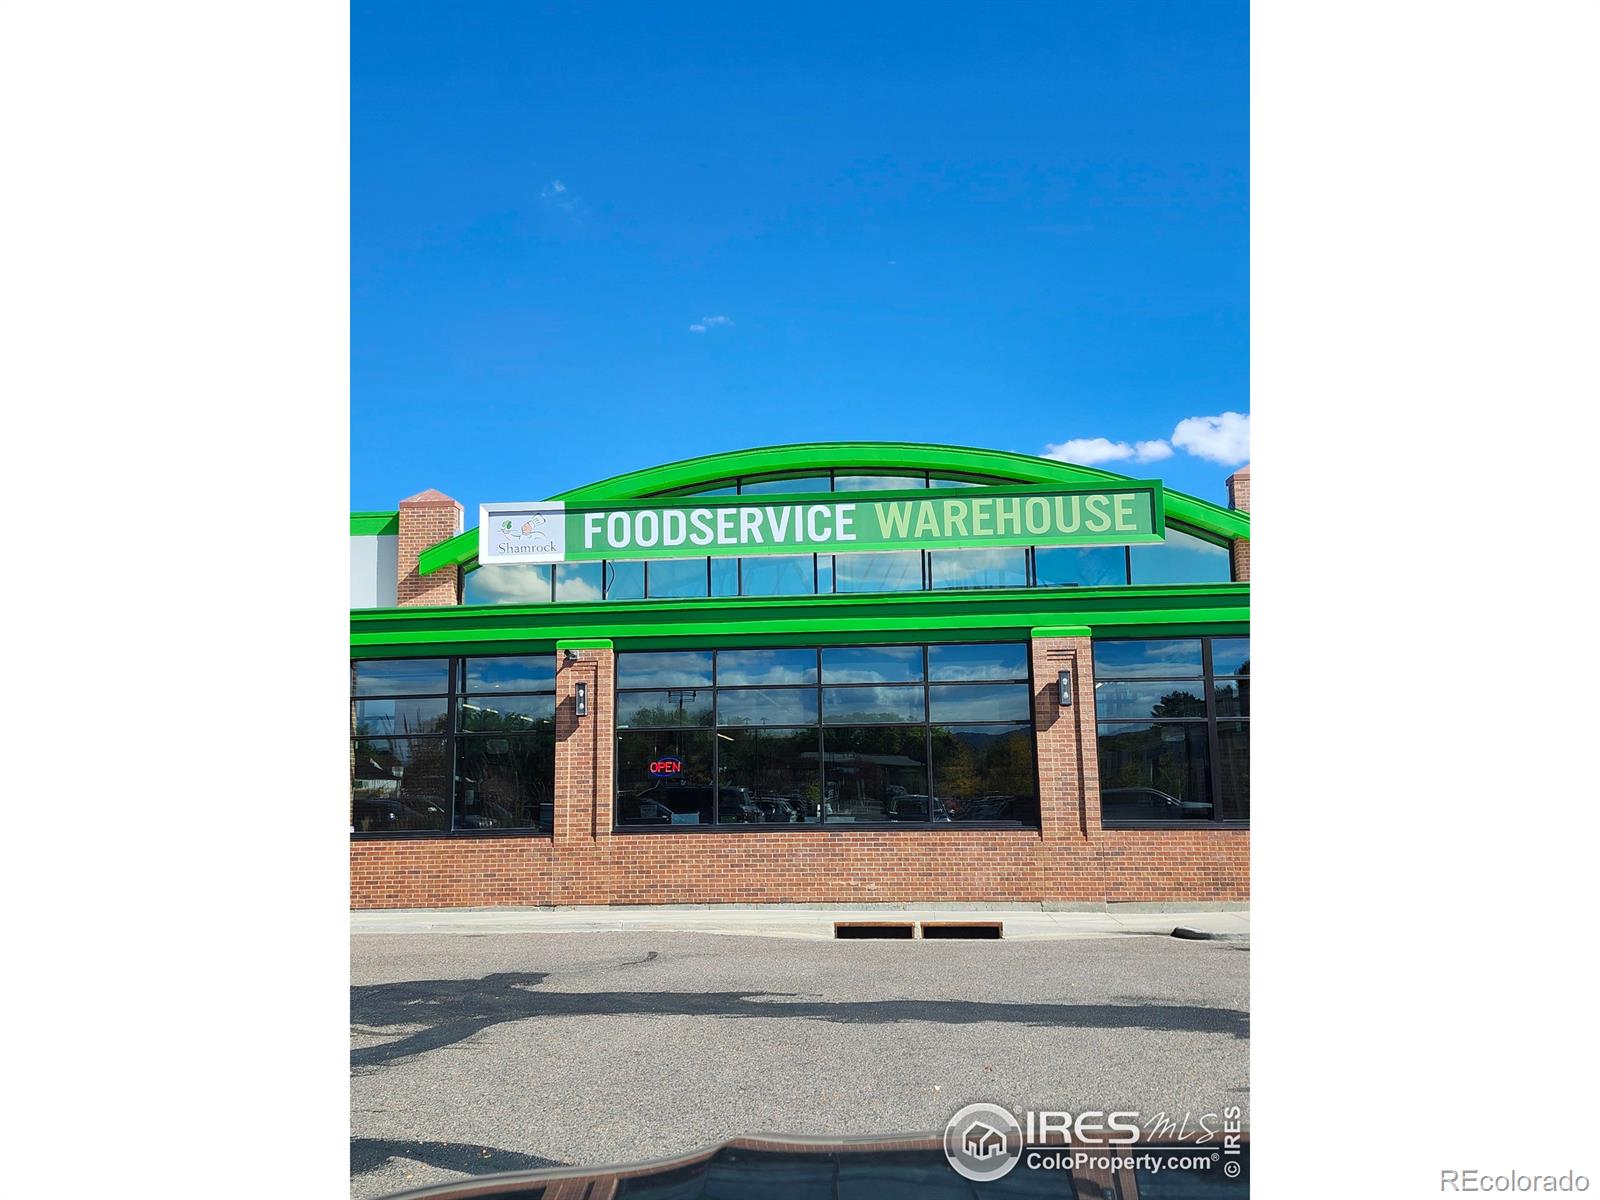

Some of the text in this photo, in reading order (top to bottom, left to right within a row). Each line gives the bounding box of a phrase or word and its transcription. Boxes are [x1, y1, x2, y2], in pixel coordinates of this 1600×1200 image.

[584, 493, 1137, 549] FOODSERVICE WAREHOUSE
[498, 541, 557, 555] Shamrock
[650, 761, 681, 773] OPEN
